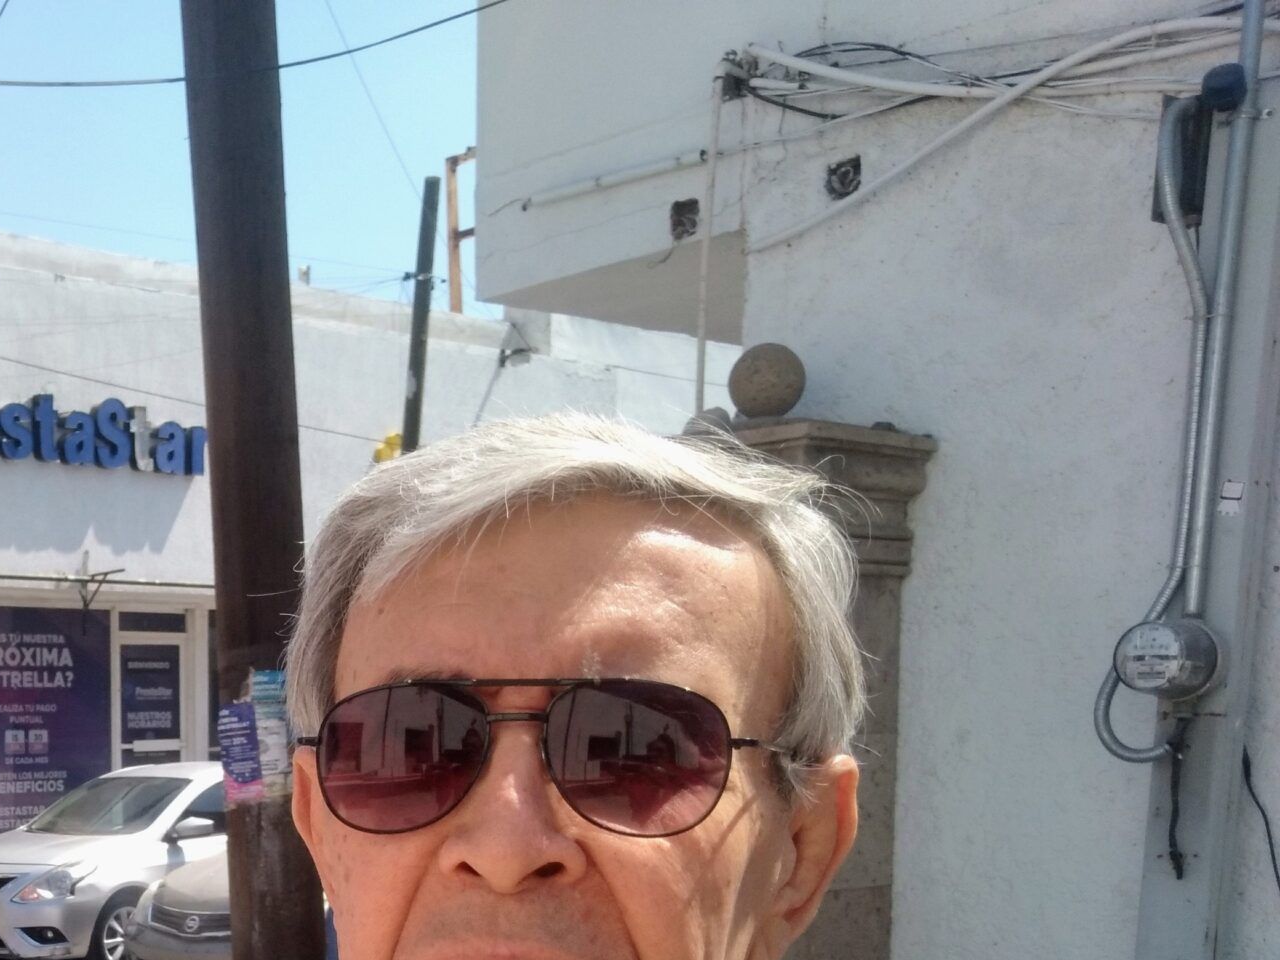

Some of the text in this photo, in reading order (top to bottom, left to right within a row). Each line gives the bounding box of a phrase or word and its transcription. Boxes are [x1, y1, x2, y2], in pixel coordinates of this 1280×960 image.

[22, 634, 65, 643] NUESTRA
[36, 704, 57, 712] PAGO
[18, 772, 32, 780] LOS
[34, 770, 67, 779] MEJORES
